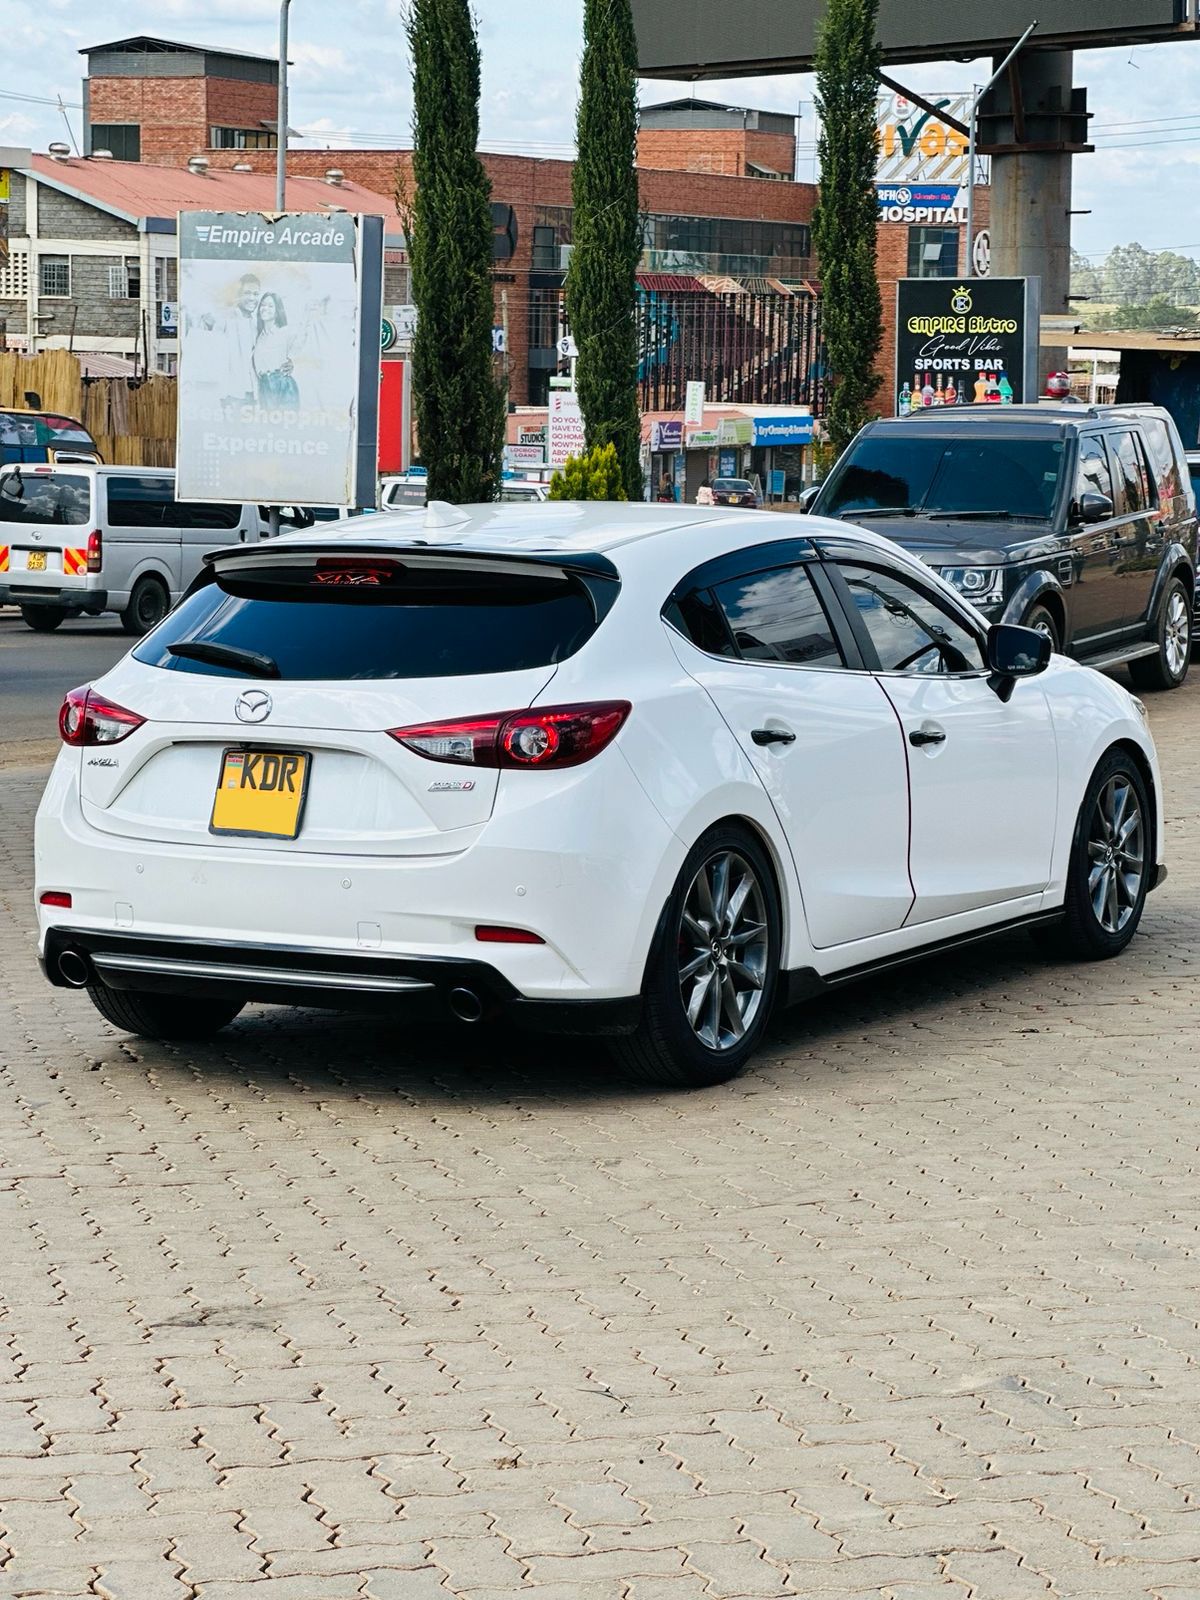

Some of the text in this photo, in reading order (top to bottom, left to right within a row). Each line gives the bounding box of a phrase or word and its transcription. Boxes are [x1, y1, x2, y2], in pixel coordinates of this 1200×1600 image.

[874, 99, 970, 157] ivas
[877, 206, 968, 223] HOSPITAL
[208, 225, 345, 248] Empire Arcade
[908, 316, 1017, 337] EMPIRE Bistro
[919, 334, 1003, 357] Good Vibes
[914, 358, 1004, 370] SPORTS BAR
[202, 432, 329, 456] Experience
[520, 433, 546, 443] STUDIOS
[240, 754, 299, 793] KDR
